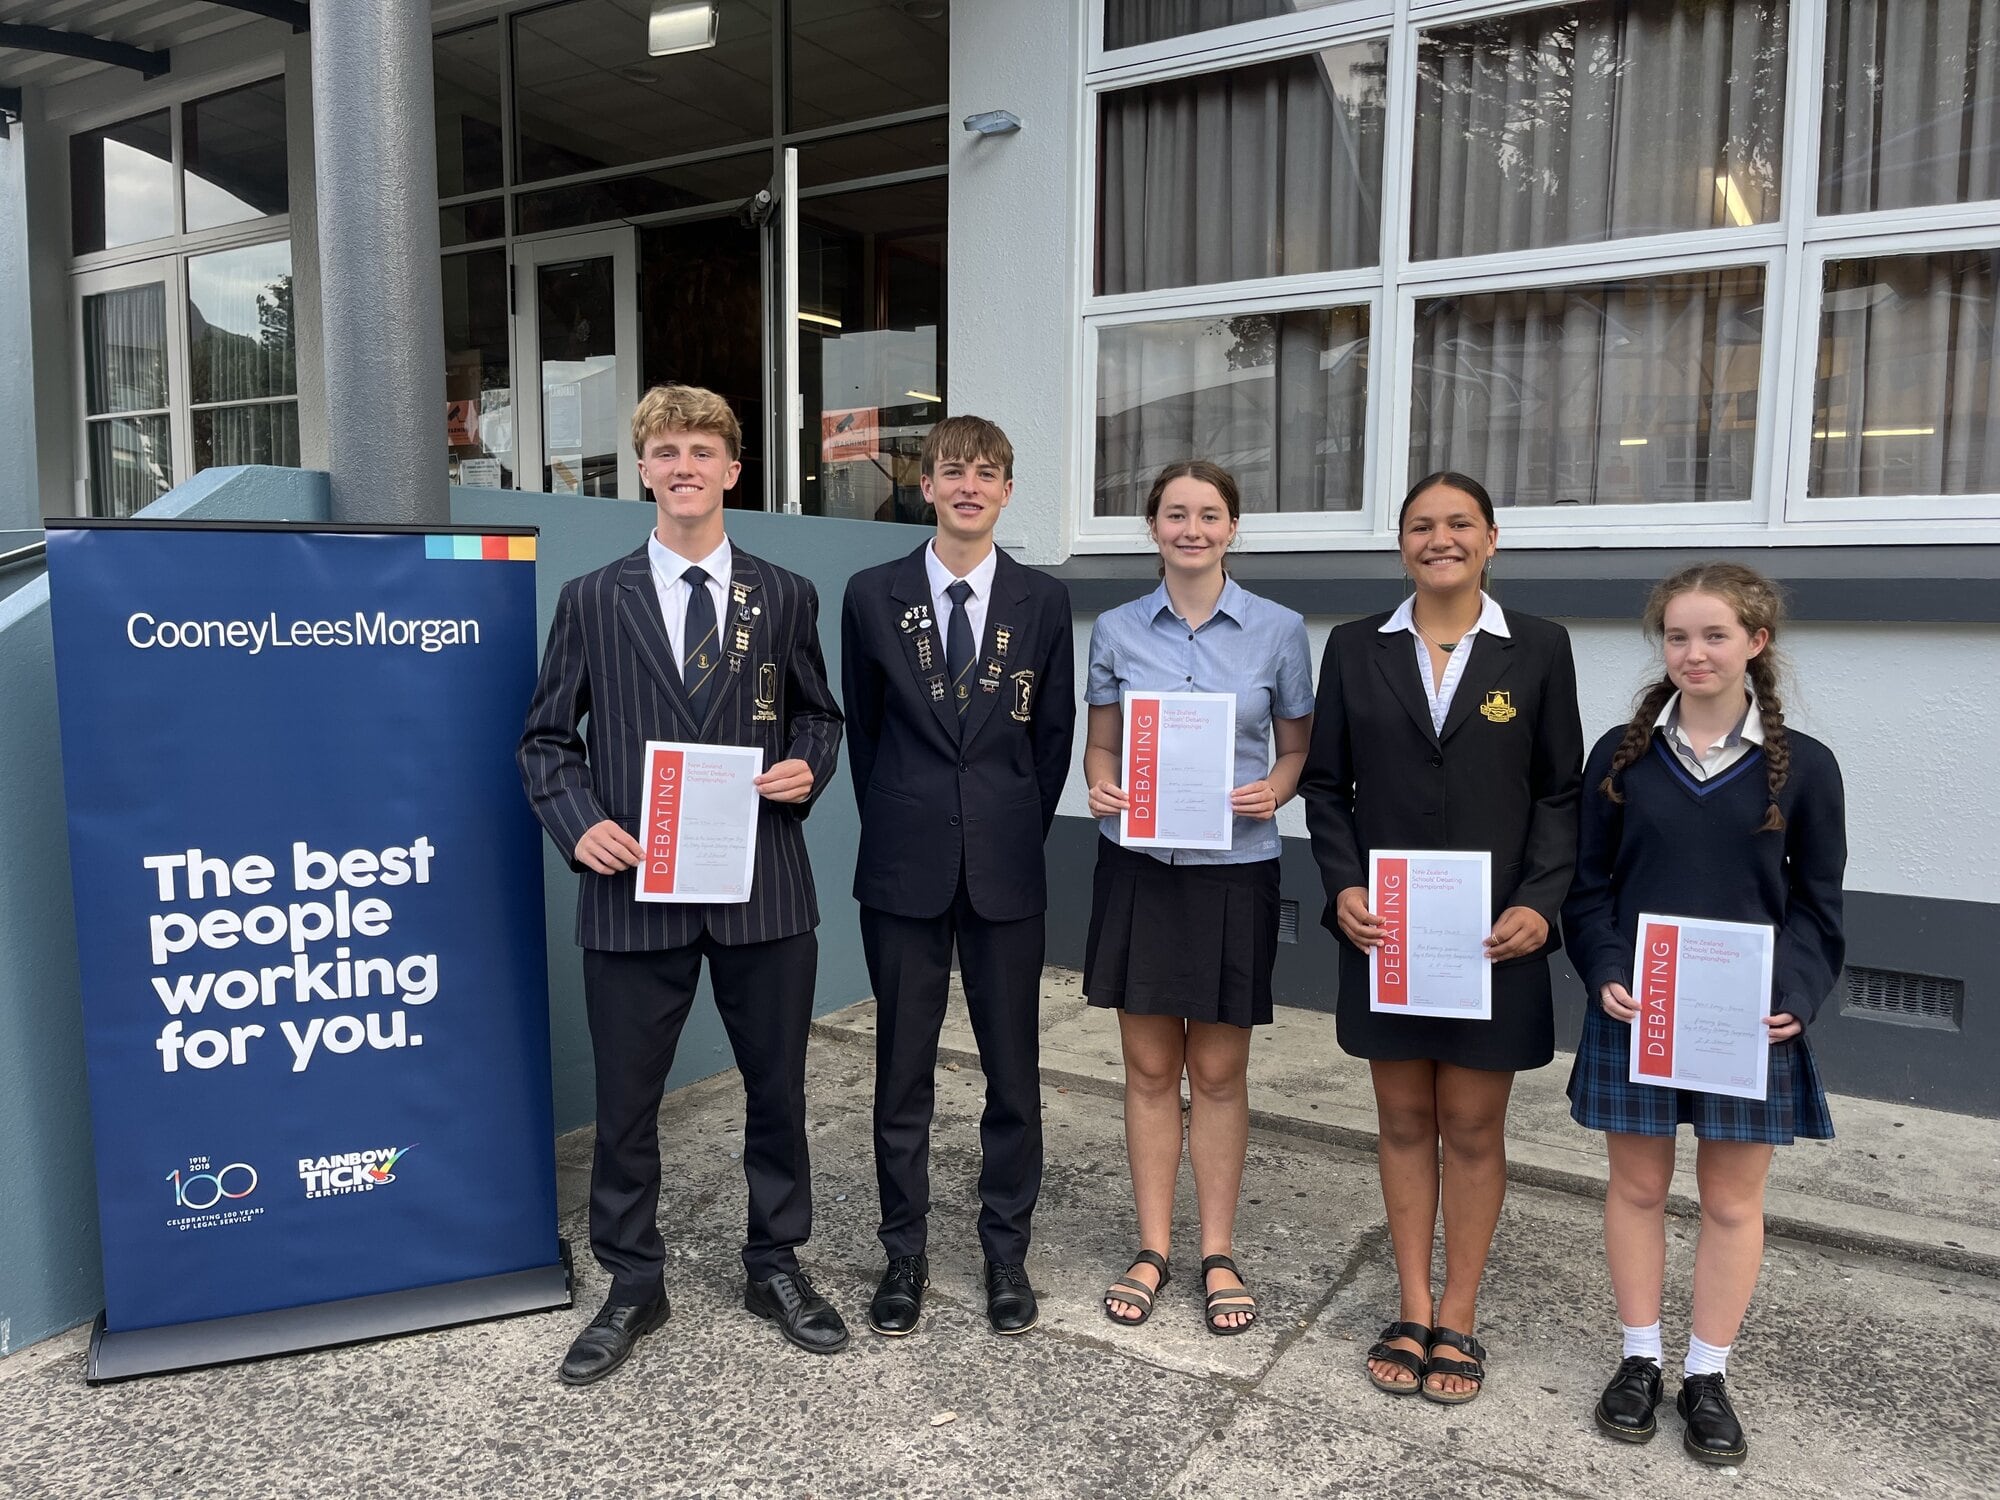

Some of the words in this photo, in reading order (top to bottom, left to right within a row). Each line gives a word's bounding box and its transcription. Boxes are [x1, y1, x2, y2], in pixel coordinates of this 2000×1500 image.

[126, 611, 481, 654] CooneyLeesMorgan
[1134, 715, 1153, 819] DEBATING
[652, 767, 676, 875] DEBATING
[143, 847, 276, 902] The
[292, 836, 436, 892] best
[149, 889, 393, 965] people
[1384, 875, 1400, 985] DEBATING
[150, 946, 439, 1016] working
[1647, 942, 1670, 1057] DEBATING
[155, 1019, 266, 1073] for
[279, 1009, 424, 1073] you.
[165, 1162, 258, 1210] 100
[189, 1163, 210, 1172] 2018
[298, 1147, 397, 1173] RAINBOW
[299, 1162, 376, 1193] TICK
[166, 1213, 221, 1227] CELEBRATING
[223, 1211, 238, 1219] 100
[239, 1207, 265, 1216] YEARS
[305, 1183, 374, 1199] CERTIFIED
[179, 1223, 190, 1231] OF
[193, 1219, 218, 1229] LEGAL
[220, 1215, 252, 1226] SERVICE
